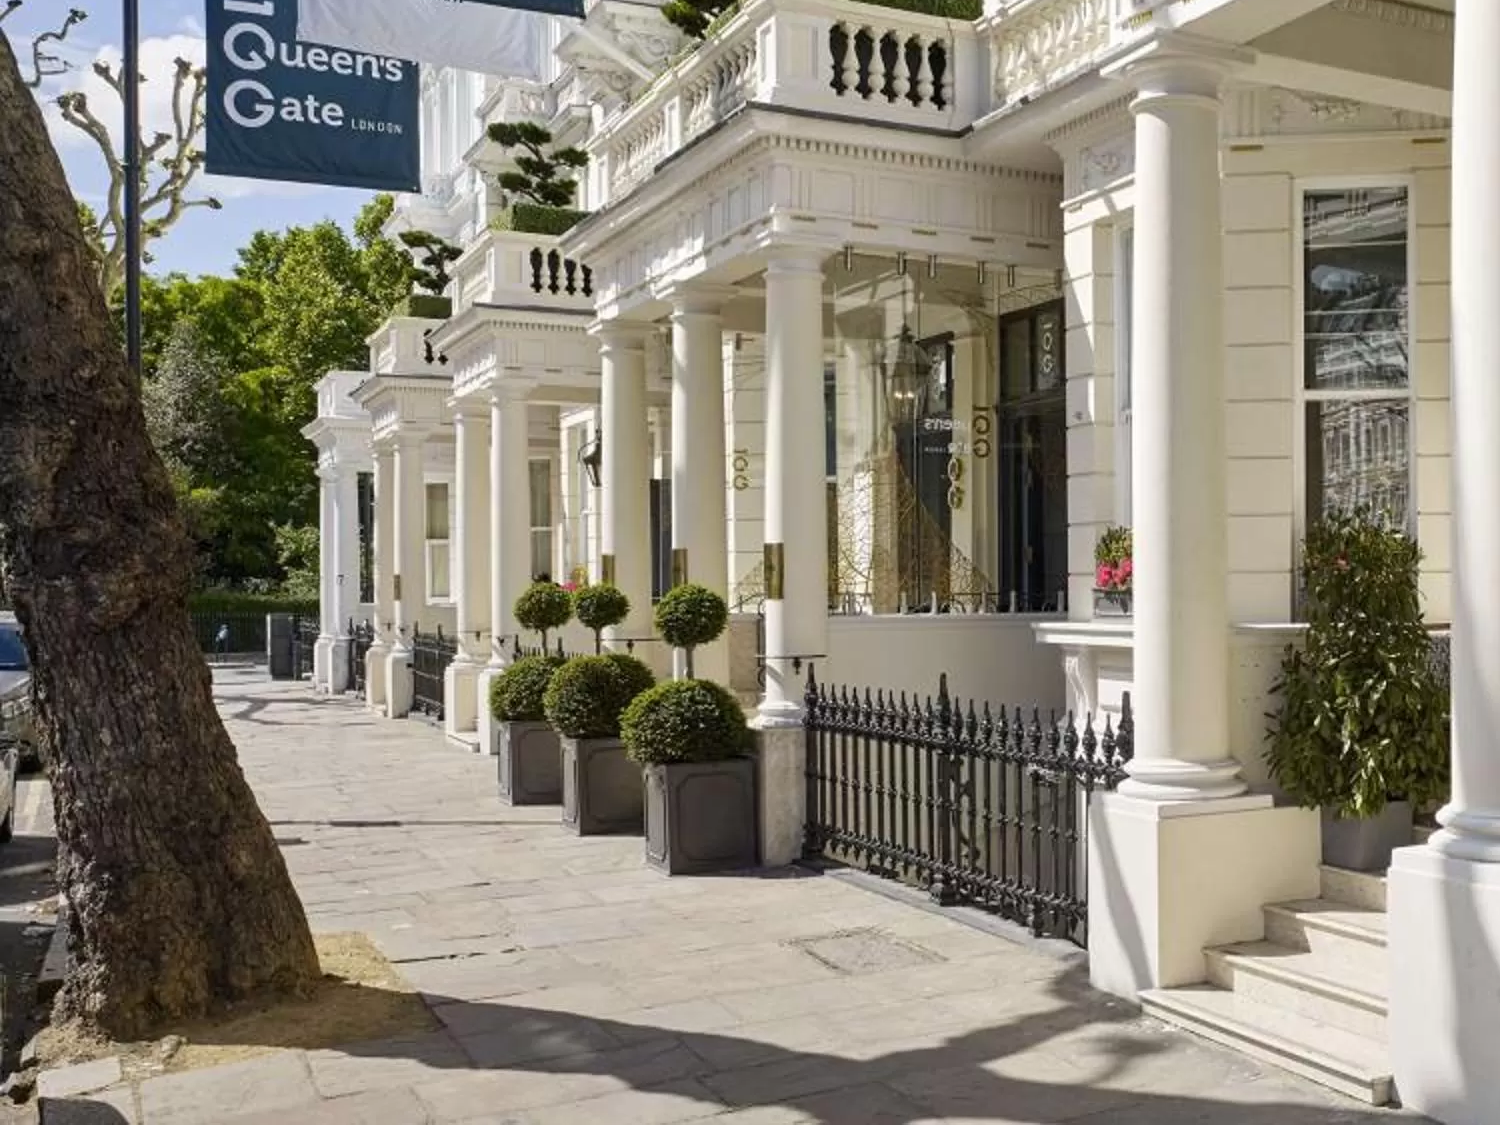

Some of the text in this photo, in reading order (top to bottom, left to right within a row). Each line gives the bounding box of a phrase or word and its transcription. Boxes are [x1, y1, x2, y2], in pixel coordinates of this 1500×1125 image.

[223, 22, 404, 83] Queen's
[223, 79, 403, 136] Gate LONDON
